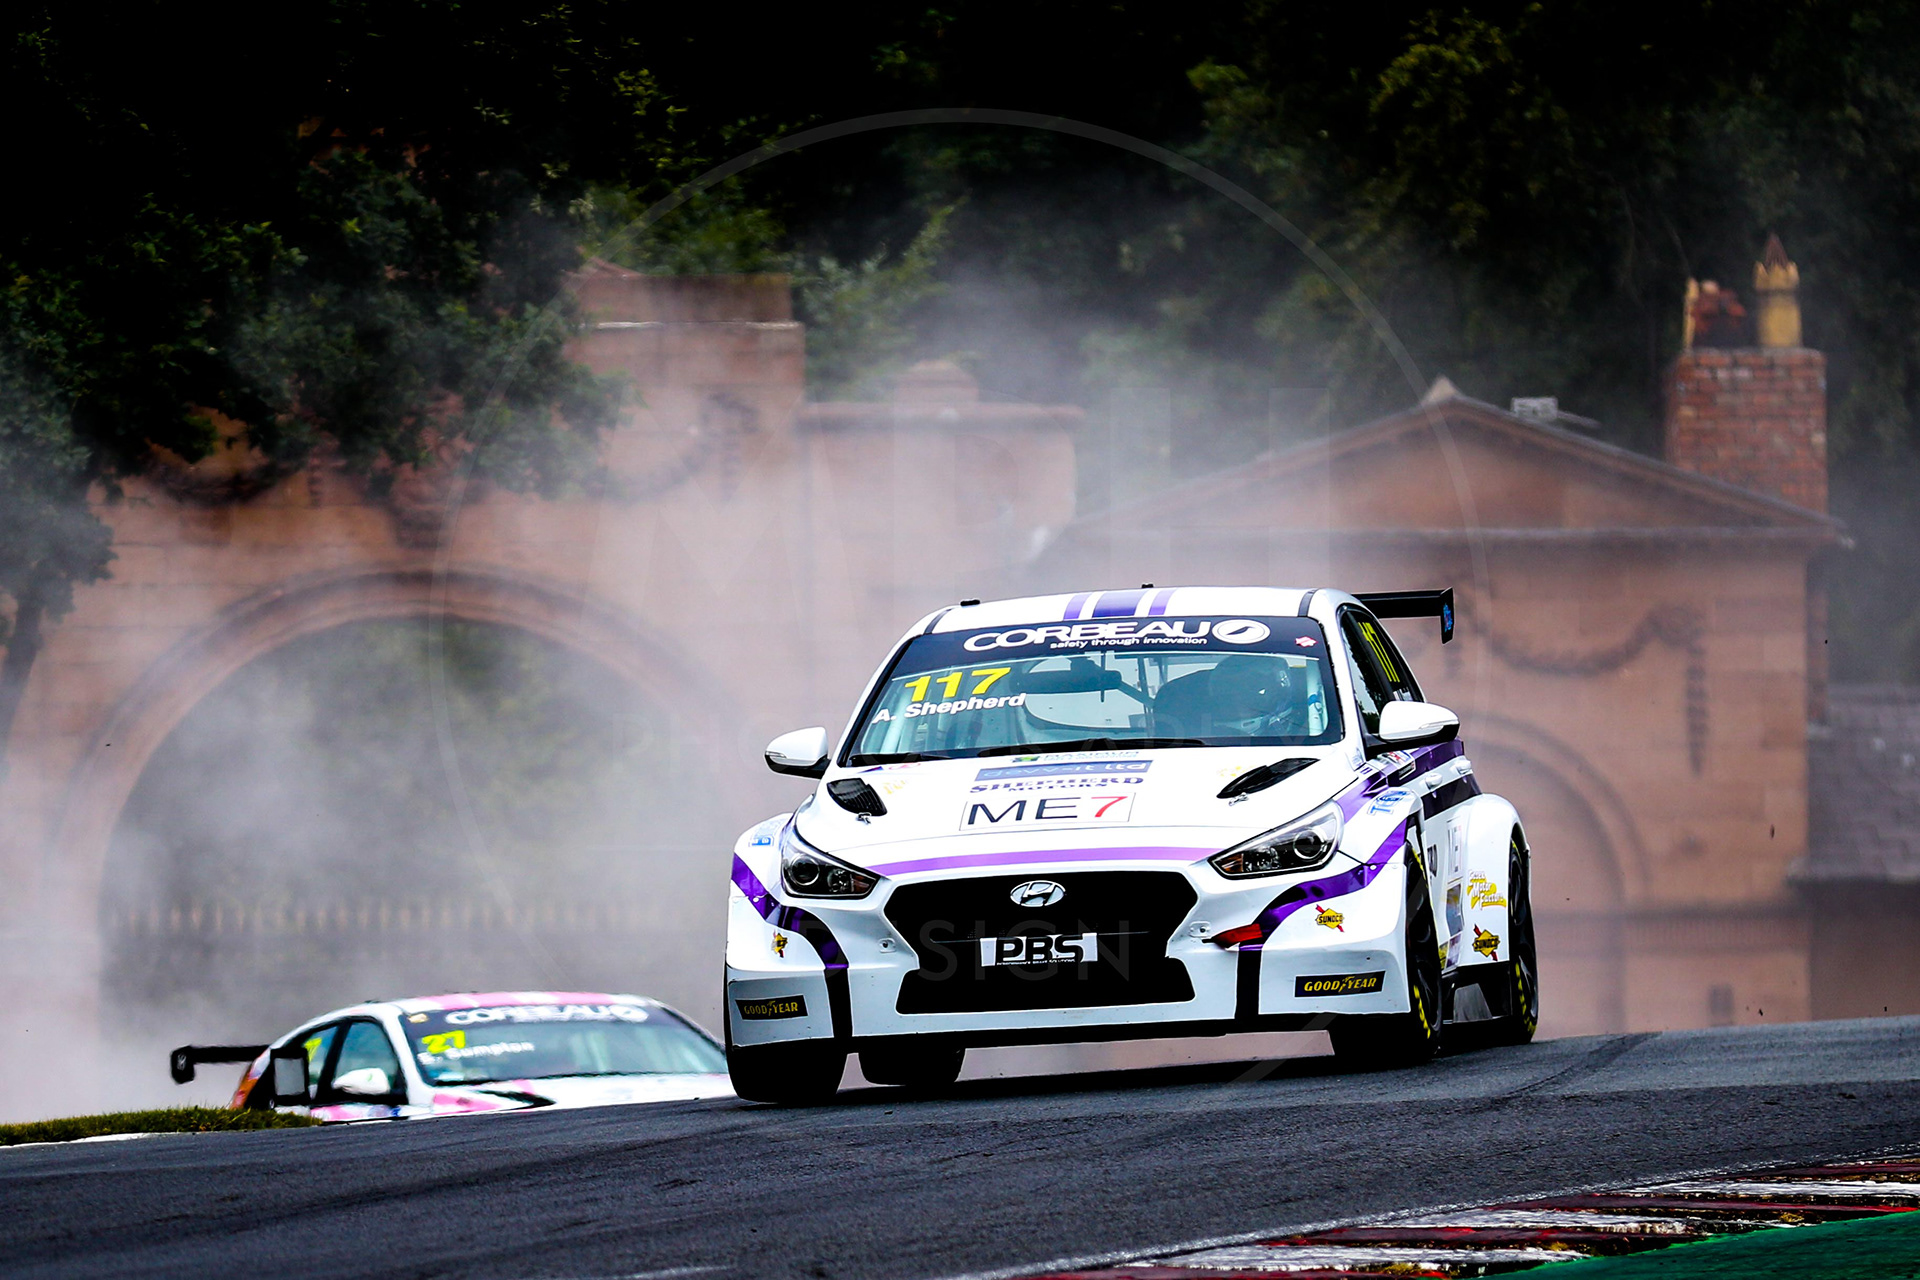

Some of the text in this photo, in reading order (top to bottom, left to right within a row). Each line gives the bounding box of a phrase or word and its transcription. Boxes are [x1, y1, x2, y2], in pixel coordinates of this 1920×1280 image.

[963, 620, 1209, 652] CORBEAU
[1049, 635, 1207, 649] safety through innovation
[904, 667, 1012, 702] 117
[872, 692, 1026, 724] A. Shepherd
[970, 776, 1145, 793] SHEPHERD
[1316, 914, 1344, 924] SUNOCO
[996, 936, 1085, 963] PBS
[421, 1029, 466, 1055] 27
